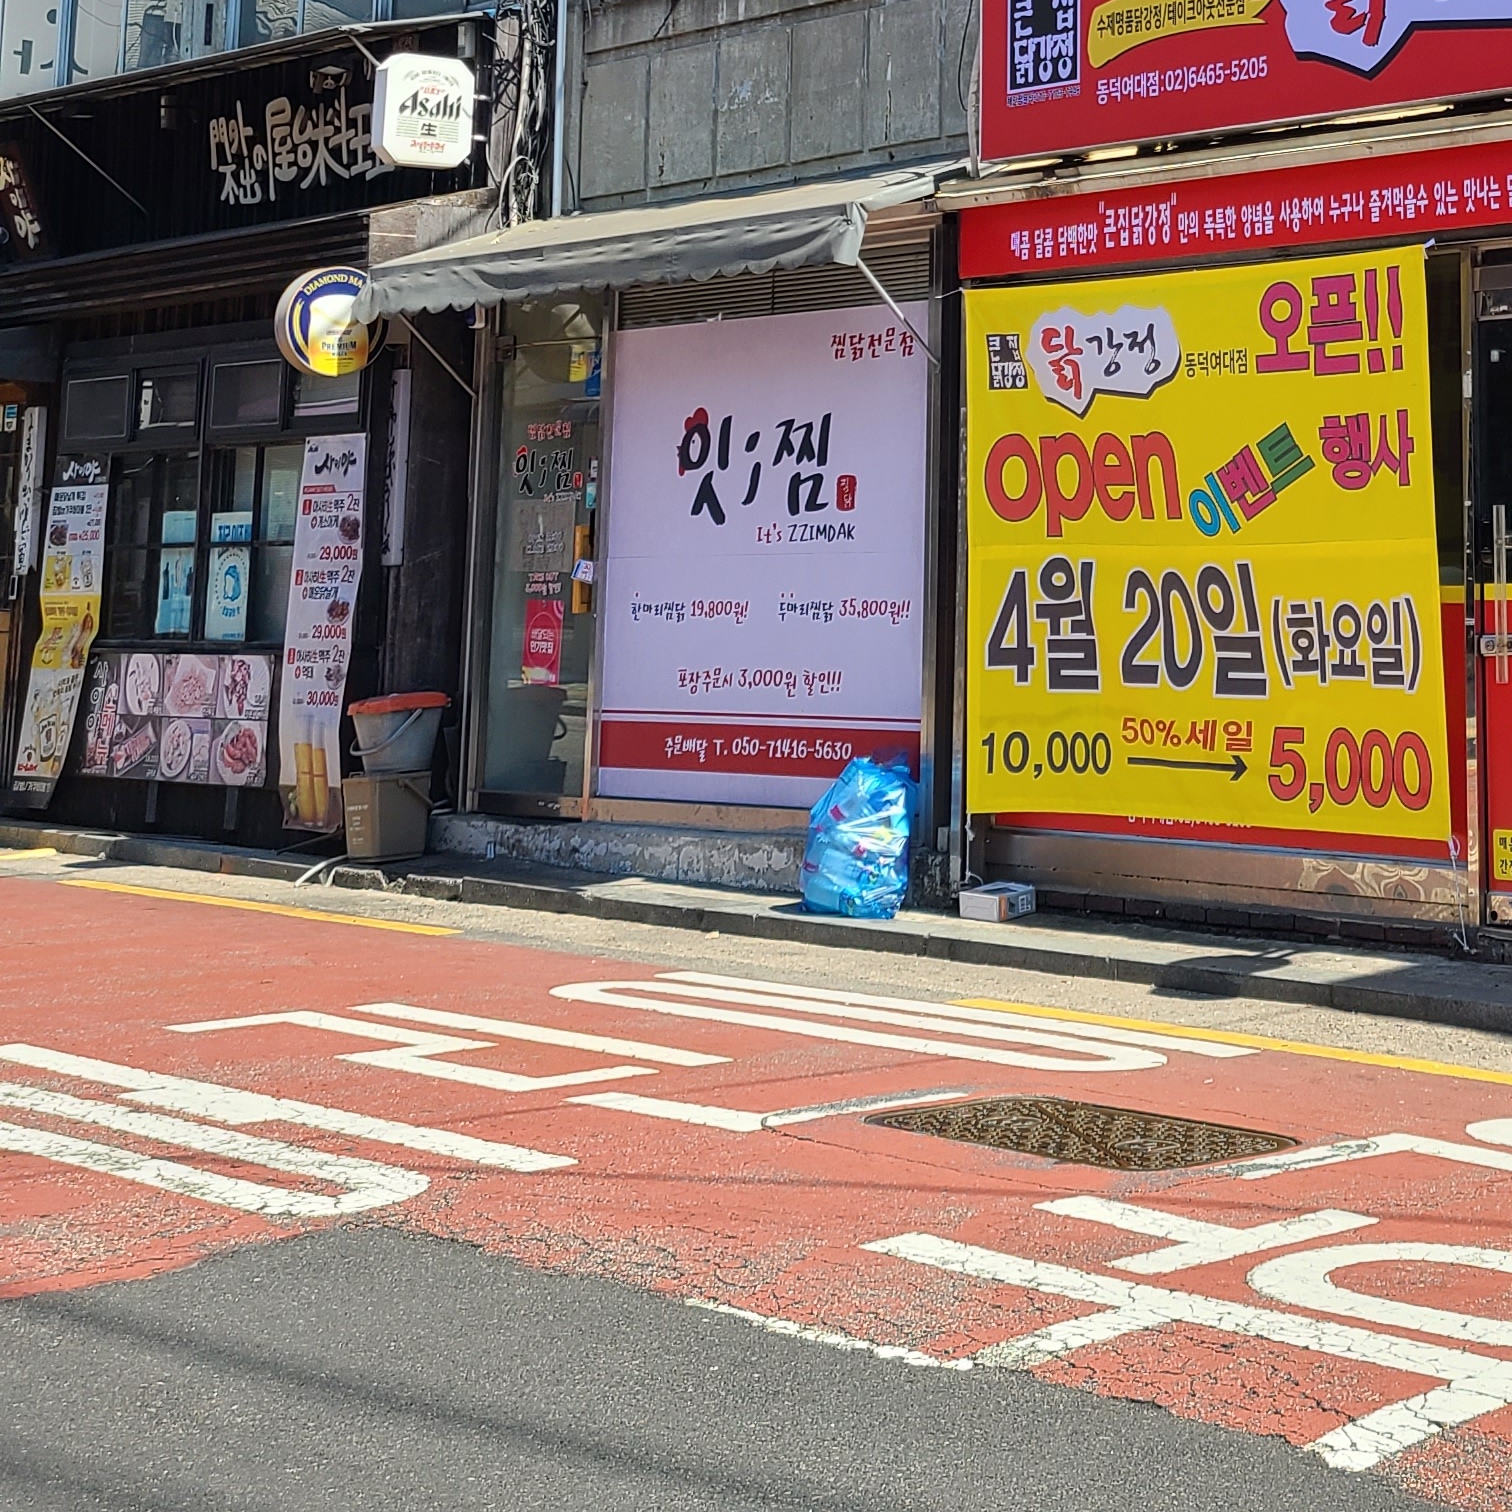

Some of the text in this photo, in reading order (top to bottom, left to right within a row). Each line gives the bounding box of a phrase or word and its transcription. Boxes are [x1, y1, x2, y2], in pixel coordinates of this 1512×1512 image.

[399, 89, 463, 121] Asahi
[421, 123, 437, 137] 生
[1034, 228, 1053, 259] 달콤
[1203, 205, 1236, 240] 독특한
[1241, 201, 1273, 238] 양념을
[1279, 194, 1324, 233] 사용하여
[1329, 190, 1364, 223] 누구나
[1369, 185, 1429, 222] 즐겨먹을수
[1433, 182, 1459, 217] 있는
[1463, 179, 1501, 213] 맛나는
[303, 273, 348, 296] DIAMOND
[1256, 266, 1405, 377] 오픈!!
[831, 327, 914, 362] 찜닭전문점
[1041, 323, 1161, 399] 닭강정
[1184, 347, 1248, 378] 동덕여대점
[1318, 409, 1415, 491] 행사
[985, 430, 1182, 538] open
[1189, 421, 1316, 538] 이벤트
[757, 522, 856, 544] It's ZZIMDAK
[631, 599, 748, 624] 한마리찜닭 19,800원!
[778, 600, 833, 623] 두마리찜닭
[986, 555, 1102, 693] 4월
[677, 668, 733, 694] 포장주문시
[738, 669, 797, 697] 3,000원
[664, 735, 708, 762] 주문배달
[732, 737, 851, 761] 050-71416-5630
[980, 730, 1112, 779] 10,000
[1267, 726, 1433, 815] 5,000
